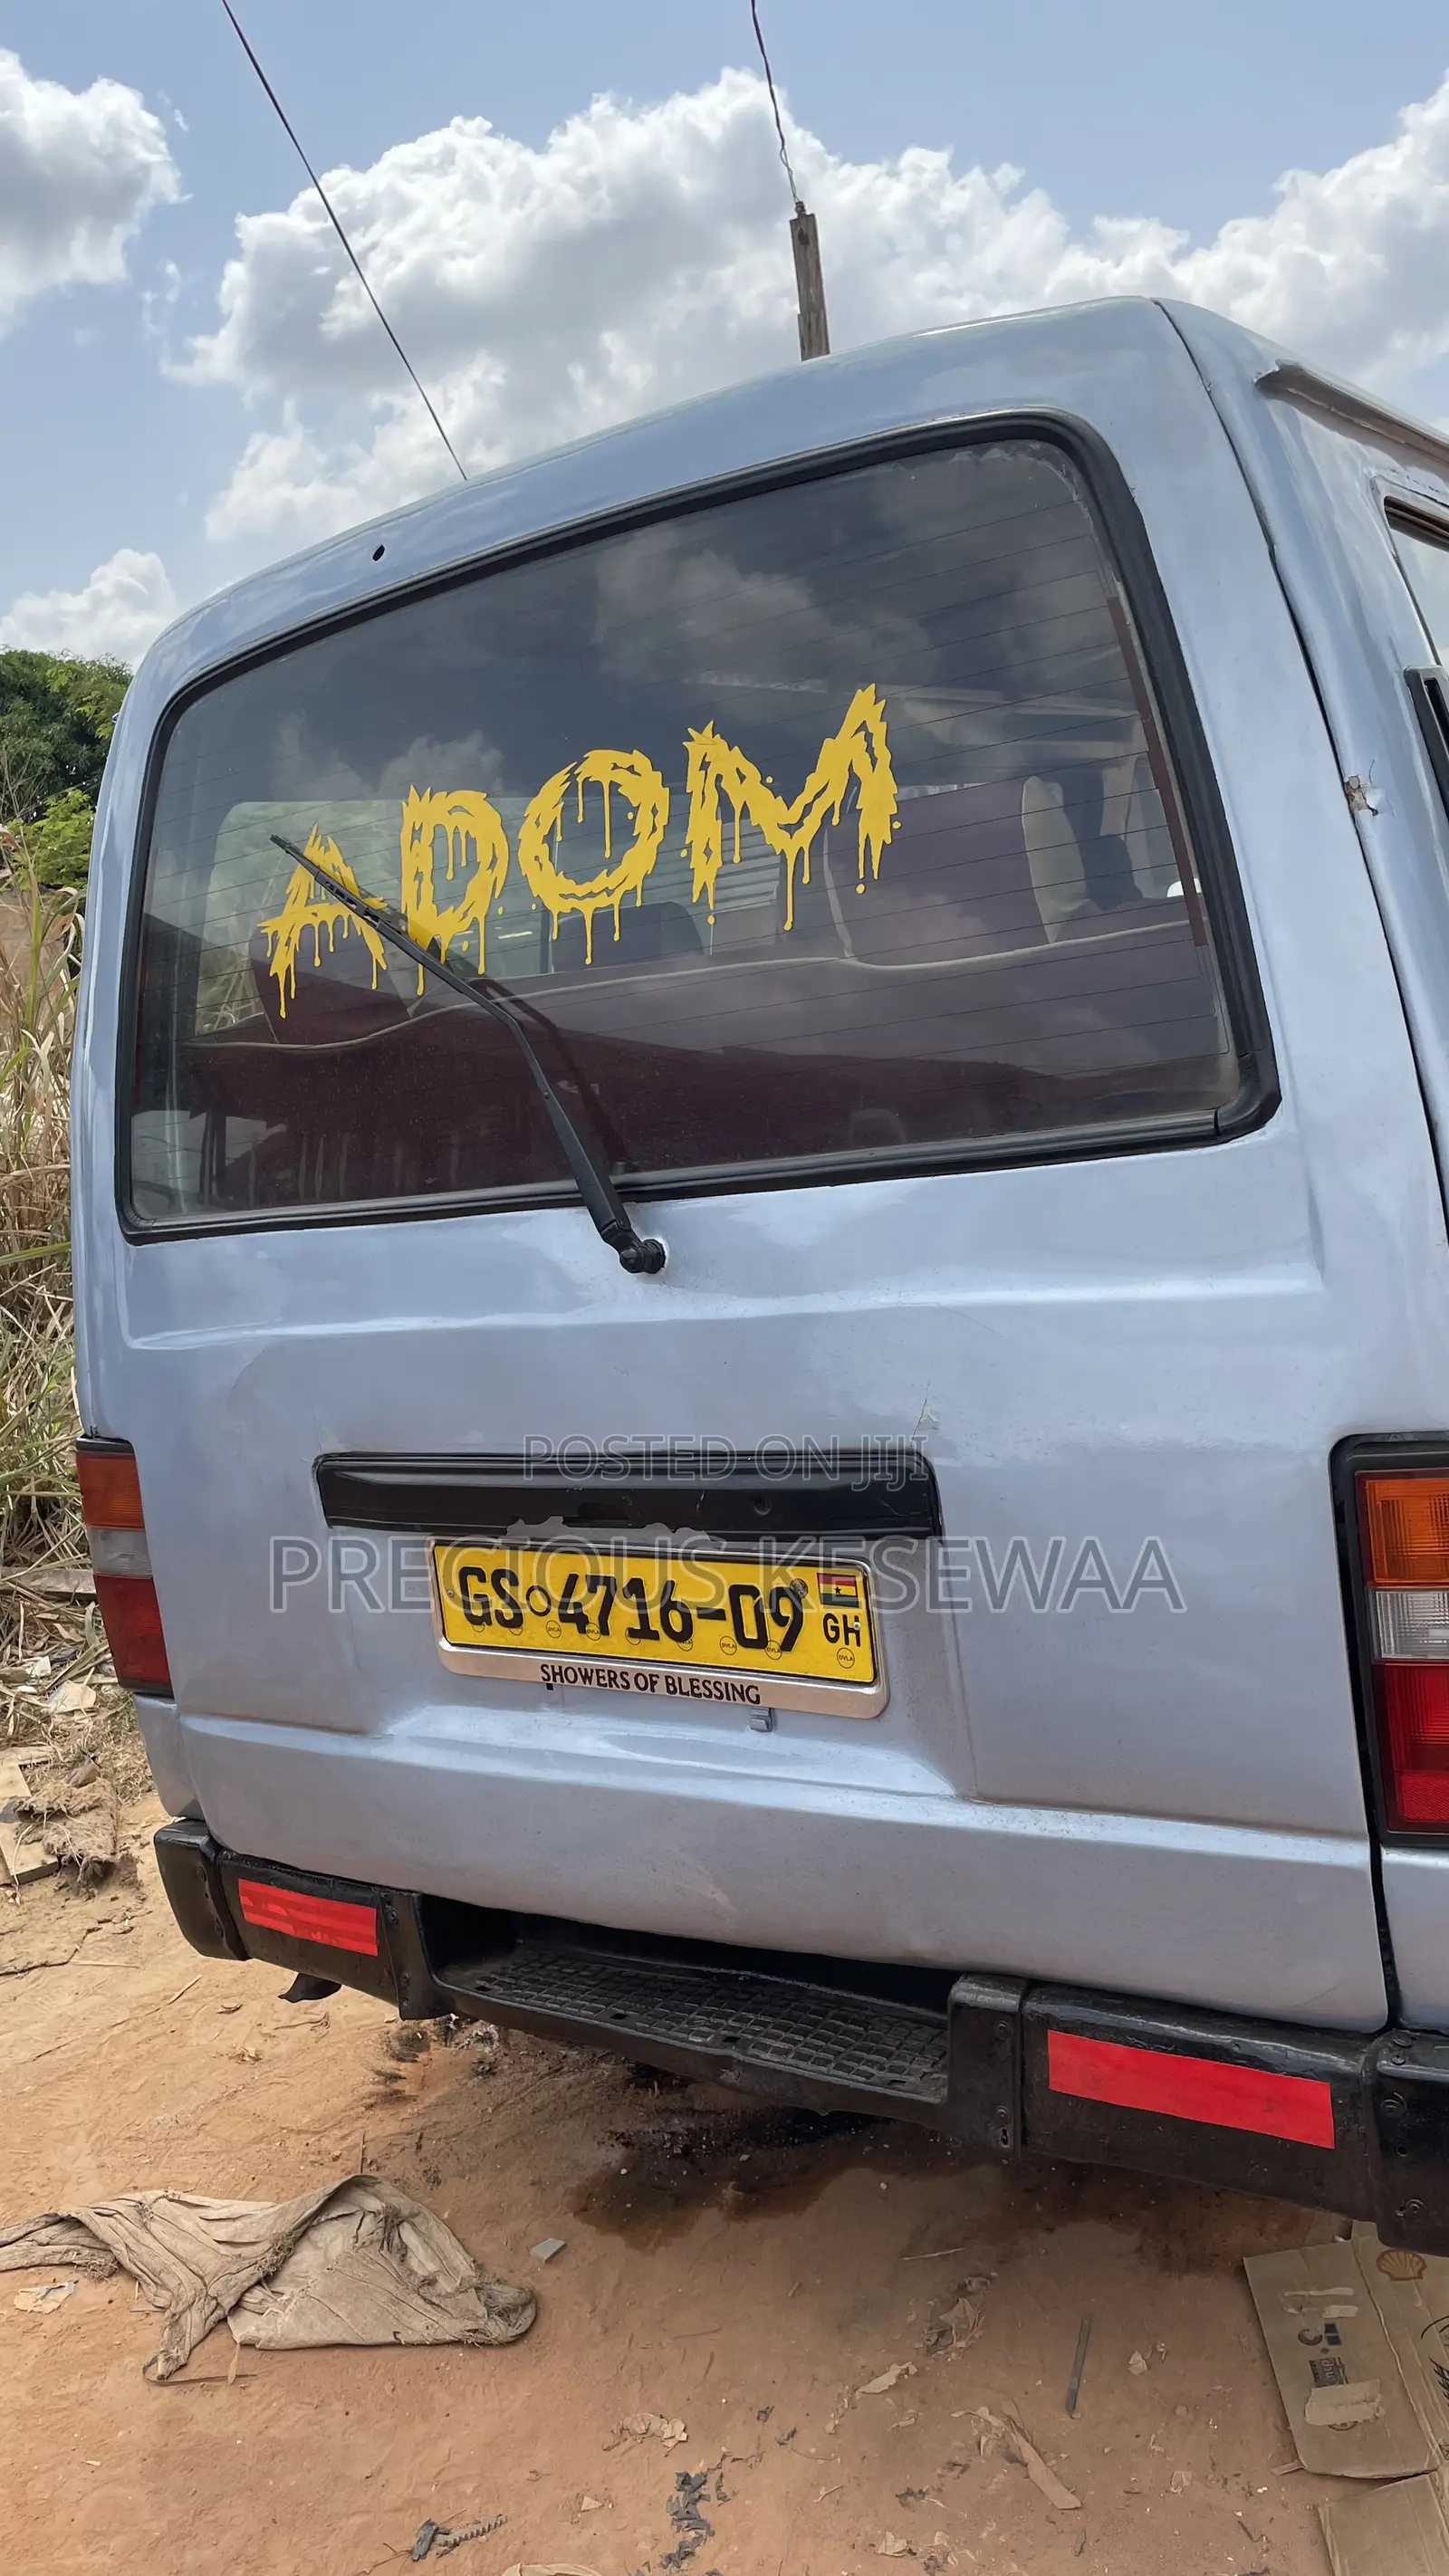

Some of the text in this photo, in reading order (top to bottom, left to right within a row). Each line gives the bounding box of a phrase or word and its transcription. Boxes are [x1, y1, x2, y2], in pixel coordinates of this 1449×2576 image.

[258, 684, 900, 1019] ADOM
[822, 1613, 861, 1648] GH
[540, 1663, 761, 1705] SHOWERS OF BLESSING
